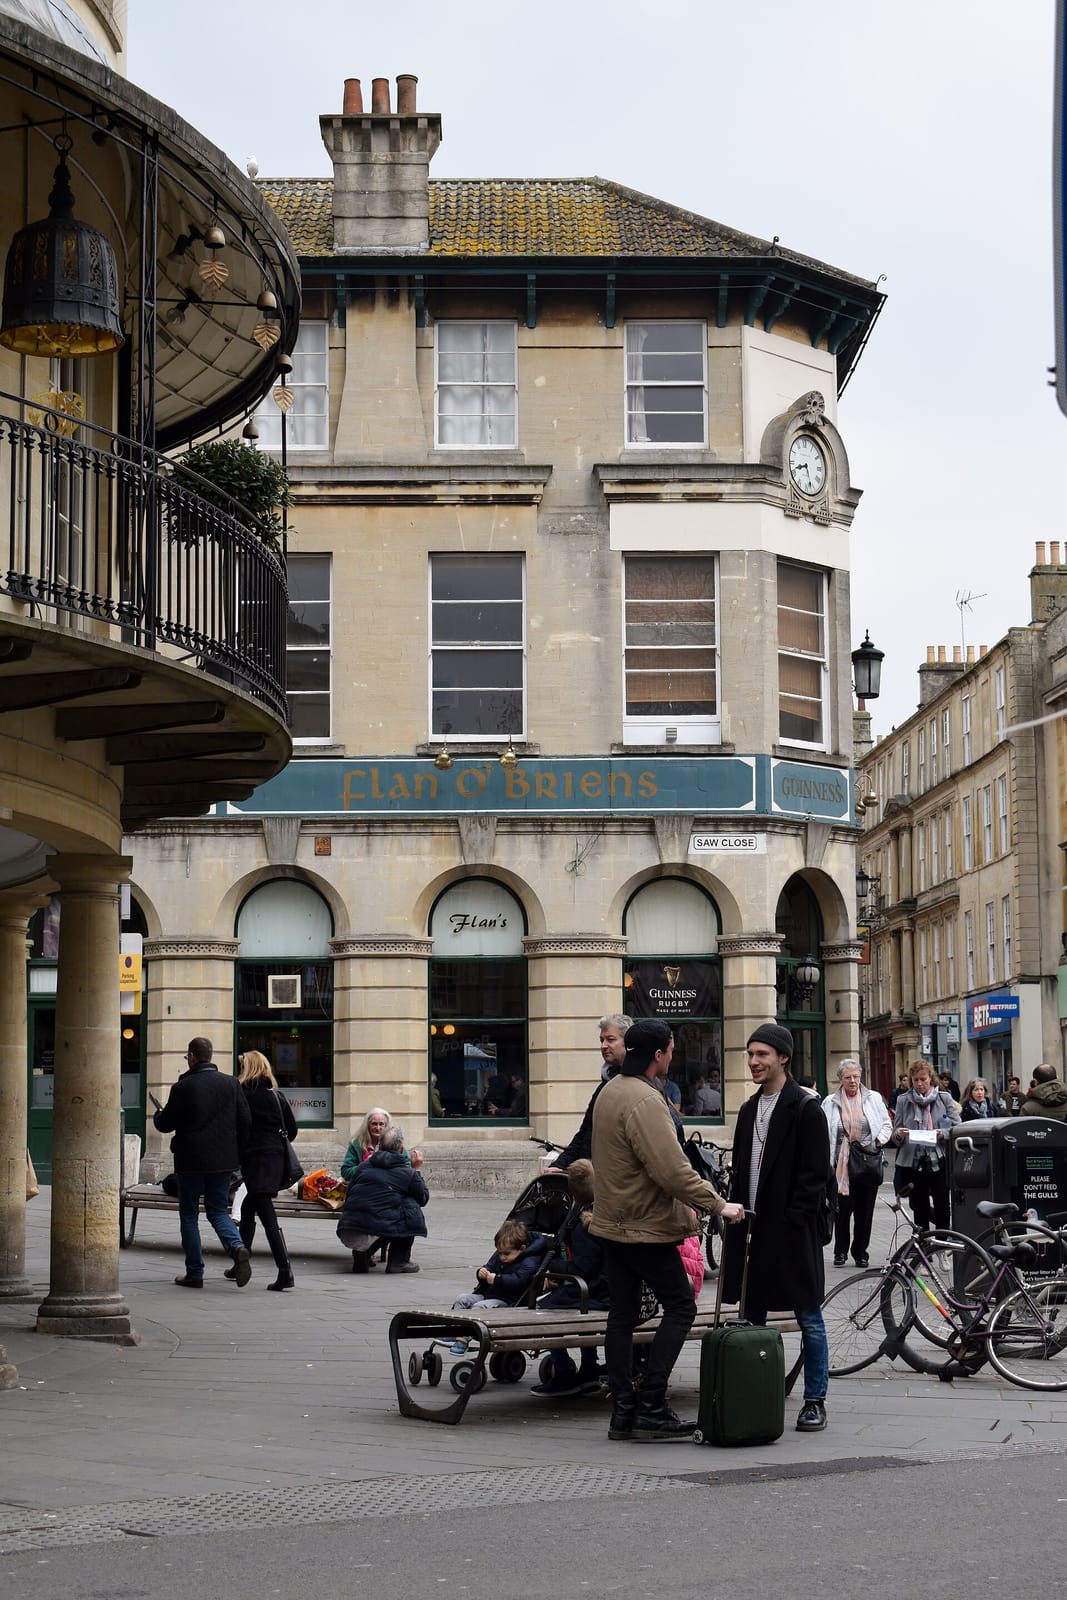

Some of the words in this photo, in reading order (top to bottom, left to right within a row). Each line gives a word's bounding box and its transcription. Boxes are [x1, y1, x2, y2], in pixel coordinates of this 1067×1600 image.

[781, 776, 842, 803] GUINNESS
[697, 839, 718, 847] SAW
[721, 839, 754, 847] CLOSE
[449, 913, 507, 933] Flan's
[649, 988, 697, 999] GUINNESS
